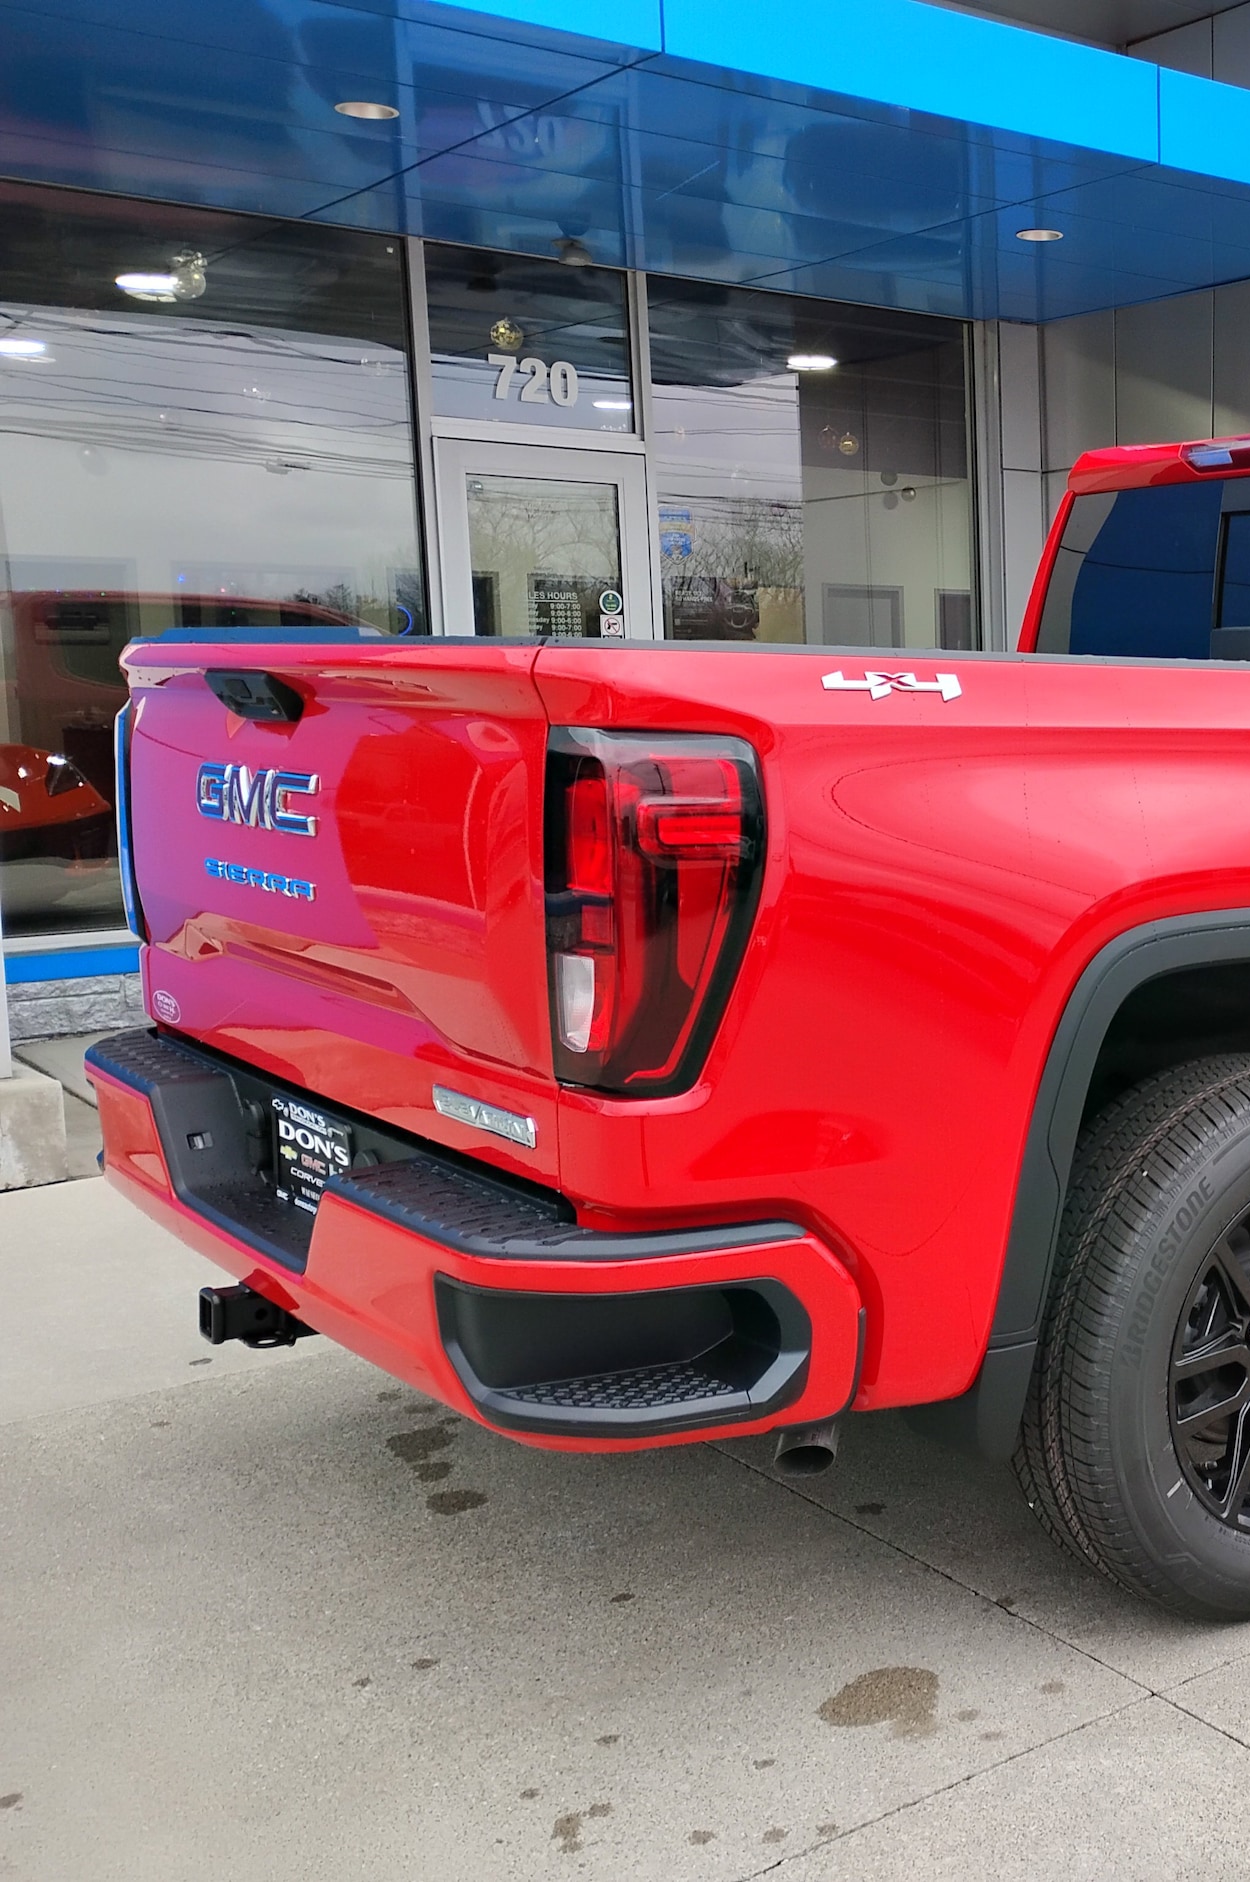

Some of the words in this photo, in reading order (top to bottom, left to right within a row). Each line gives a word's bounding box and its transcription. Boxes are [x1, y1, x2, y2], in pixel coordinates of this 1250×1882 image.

[486, 353, 579, 408] 720
[547, 592, 578, 600] HOURS
[196, 762, 320, 837] GMC
[204, 857, 317, 902] SIERRA
[287, 1102, 327, 1128] DON'S
[278, 1119, 349, 1167] DON'S
[301, 1153, 326, 1175] GMC
[1118, 1175, 1215, 1370] BRIDGESTONE
